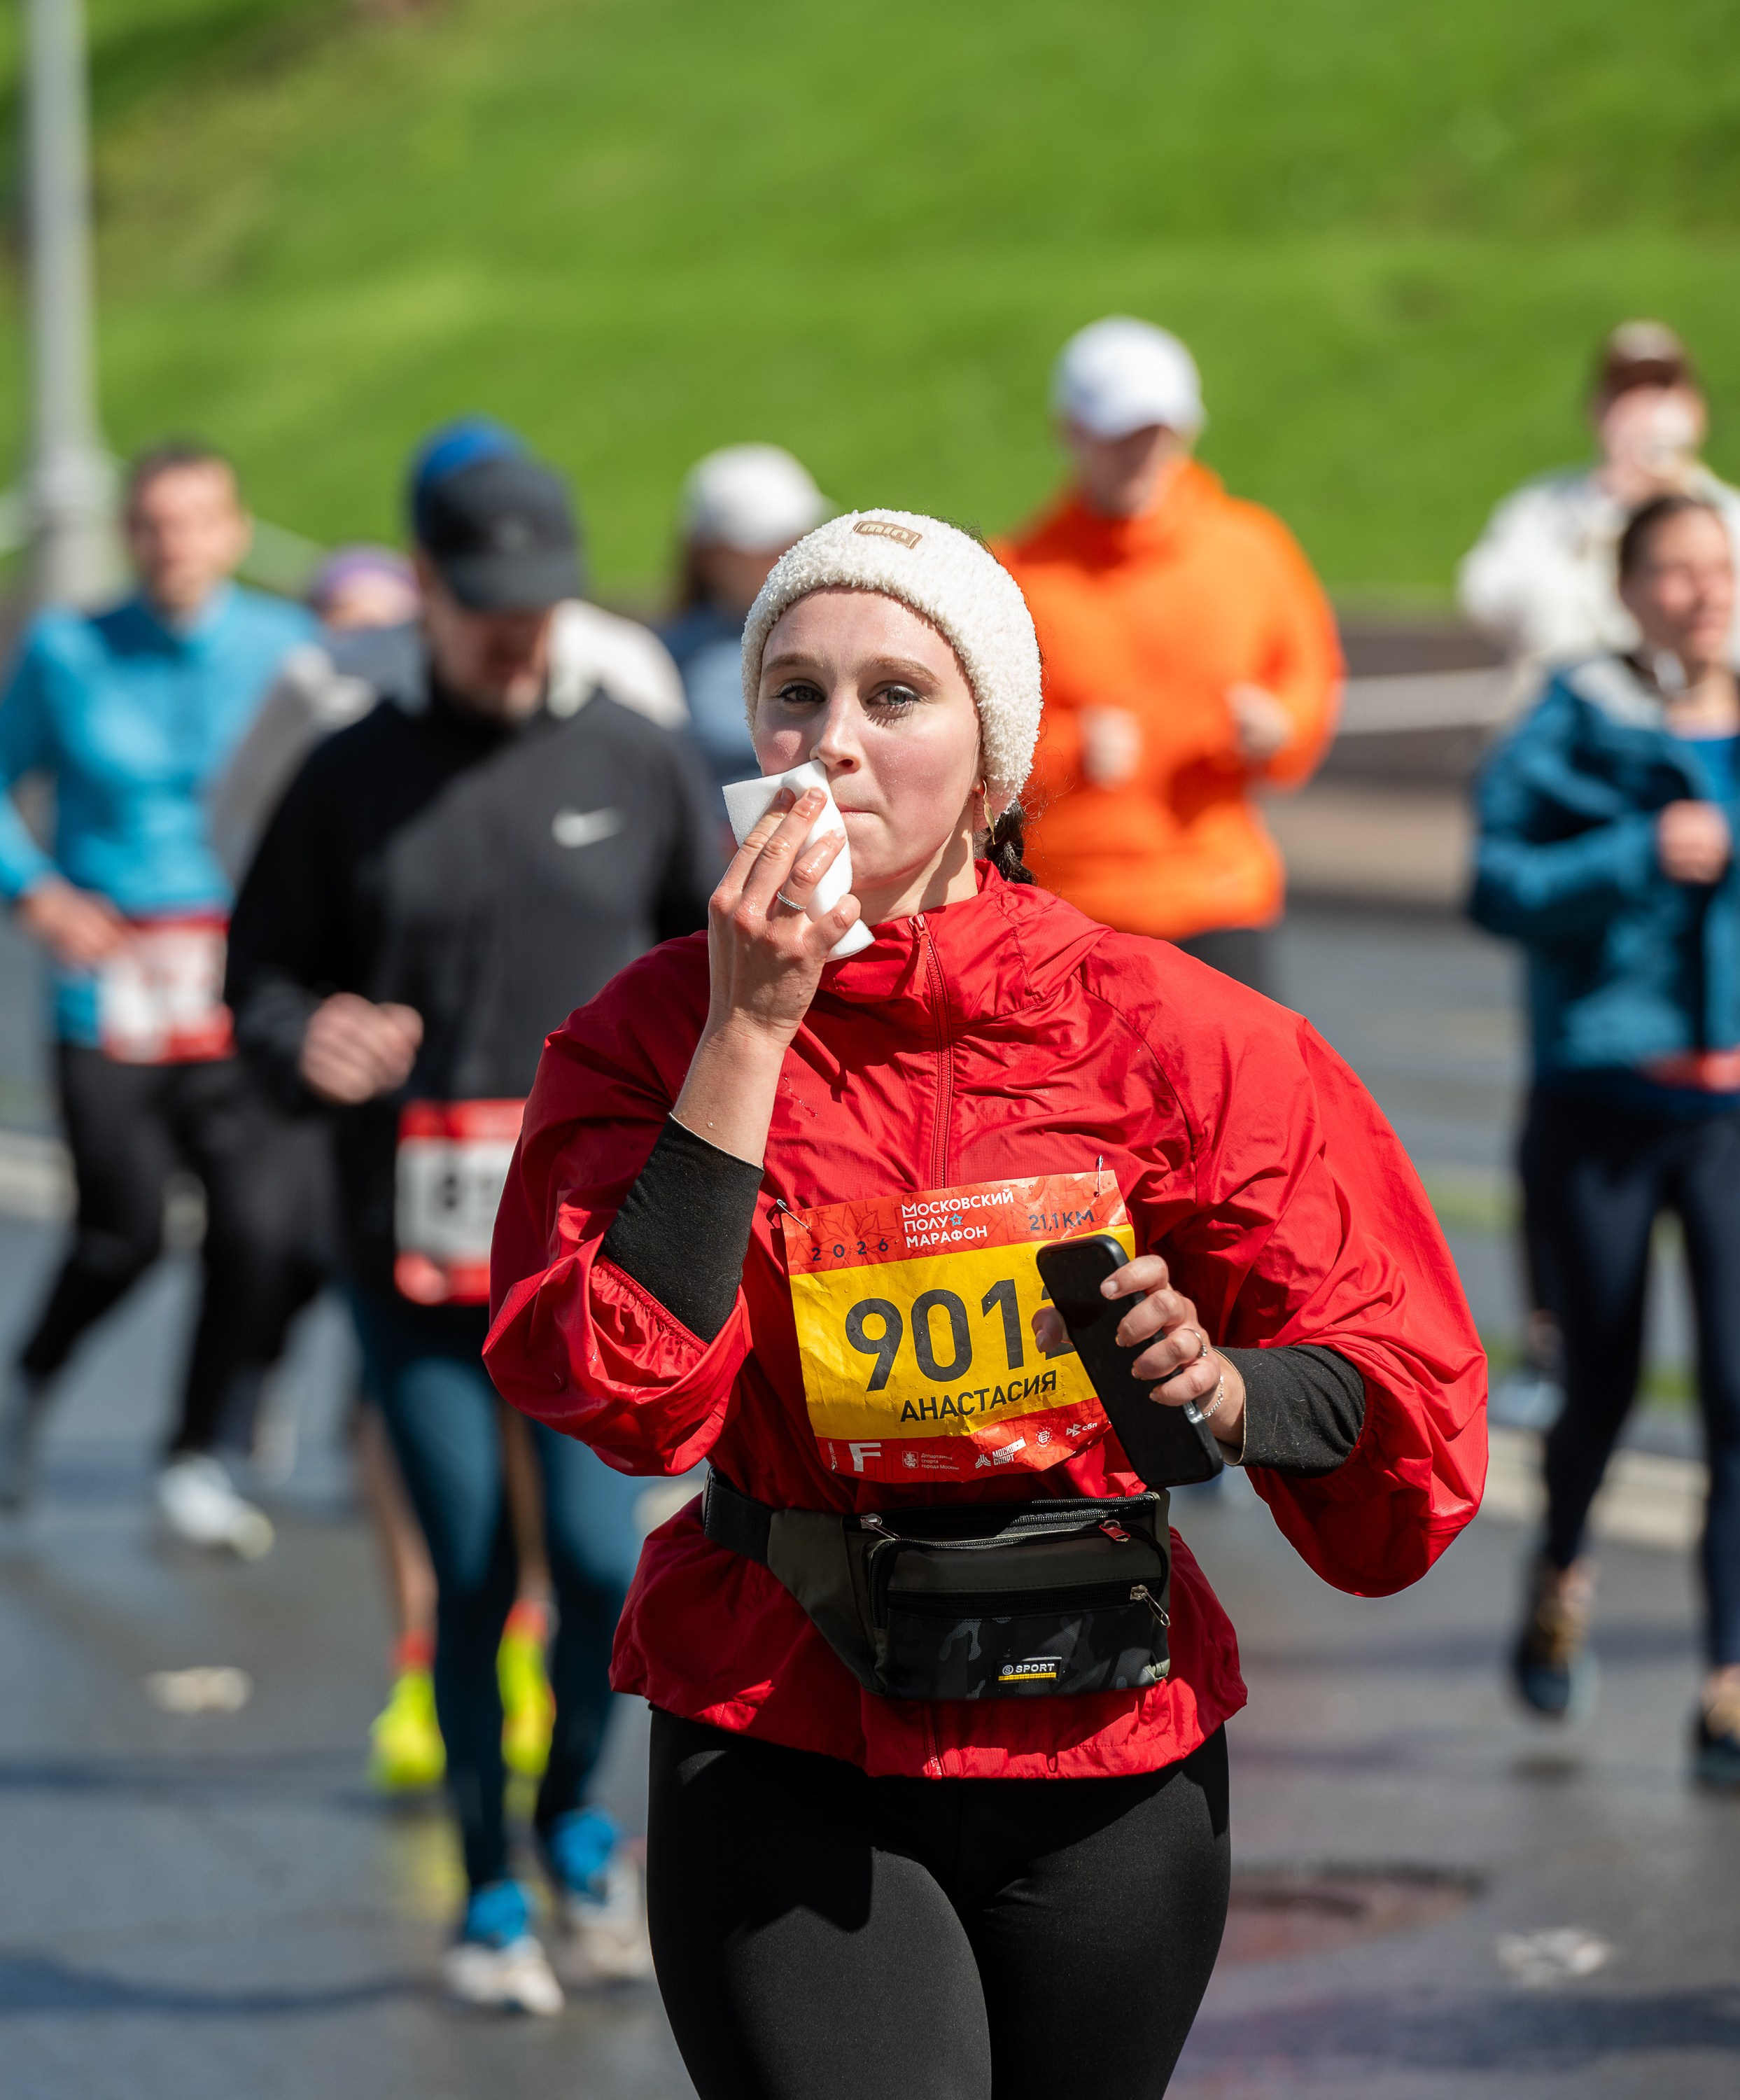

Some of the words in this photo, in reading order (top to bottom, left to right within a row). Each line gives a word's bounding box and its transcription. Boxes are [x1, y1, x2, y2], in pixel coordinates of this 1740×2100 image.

[901, 1189, 1014, 1219] МОСКОВСКИЙ
[904, 1215, 950, 1233] ПОЛУ
[906, 1225, 988, 1249] МАРАФОН
[900, 1370, 1057, 1422] АНАСТАСИЯ
[848, 1443, 881, 1472] F
[921, 1452, 953, 1461] Департамент
[993, 1453, 1014, 1465] СПОРТ
[1016, 1663, 1055, 1673] SPORT
